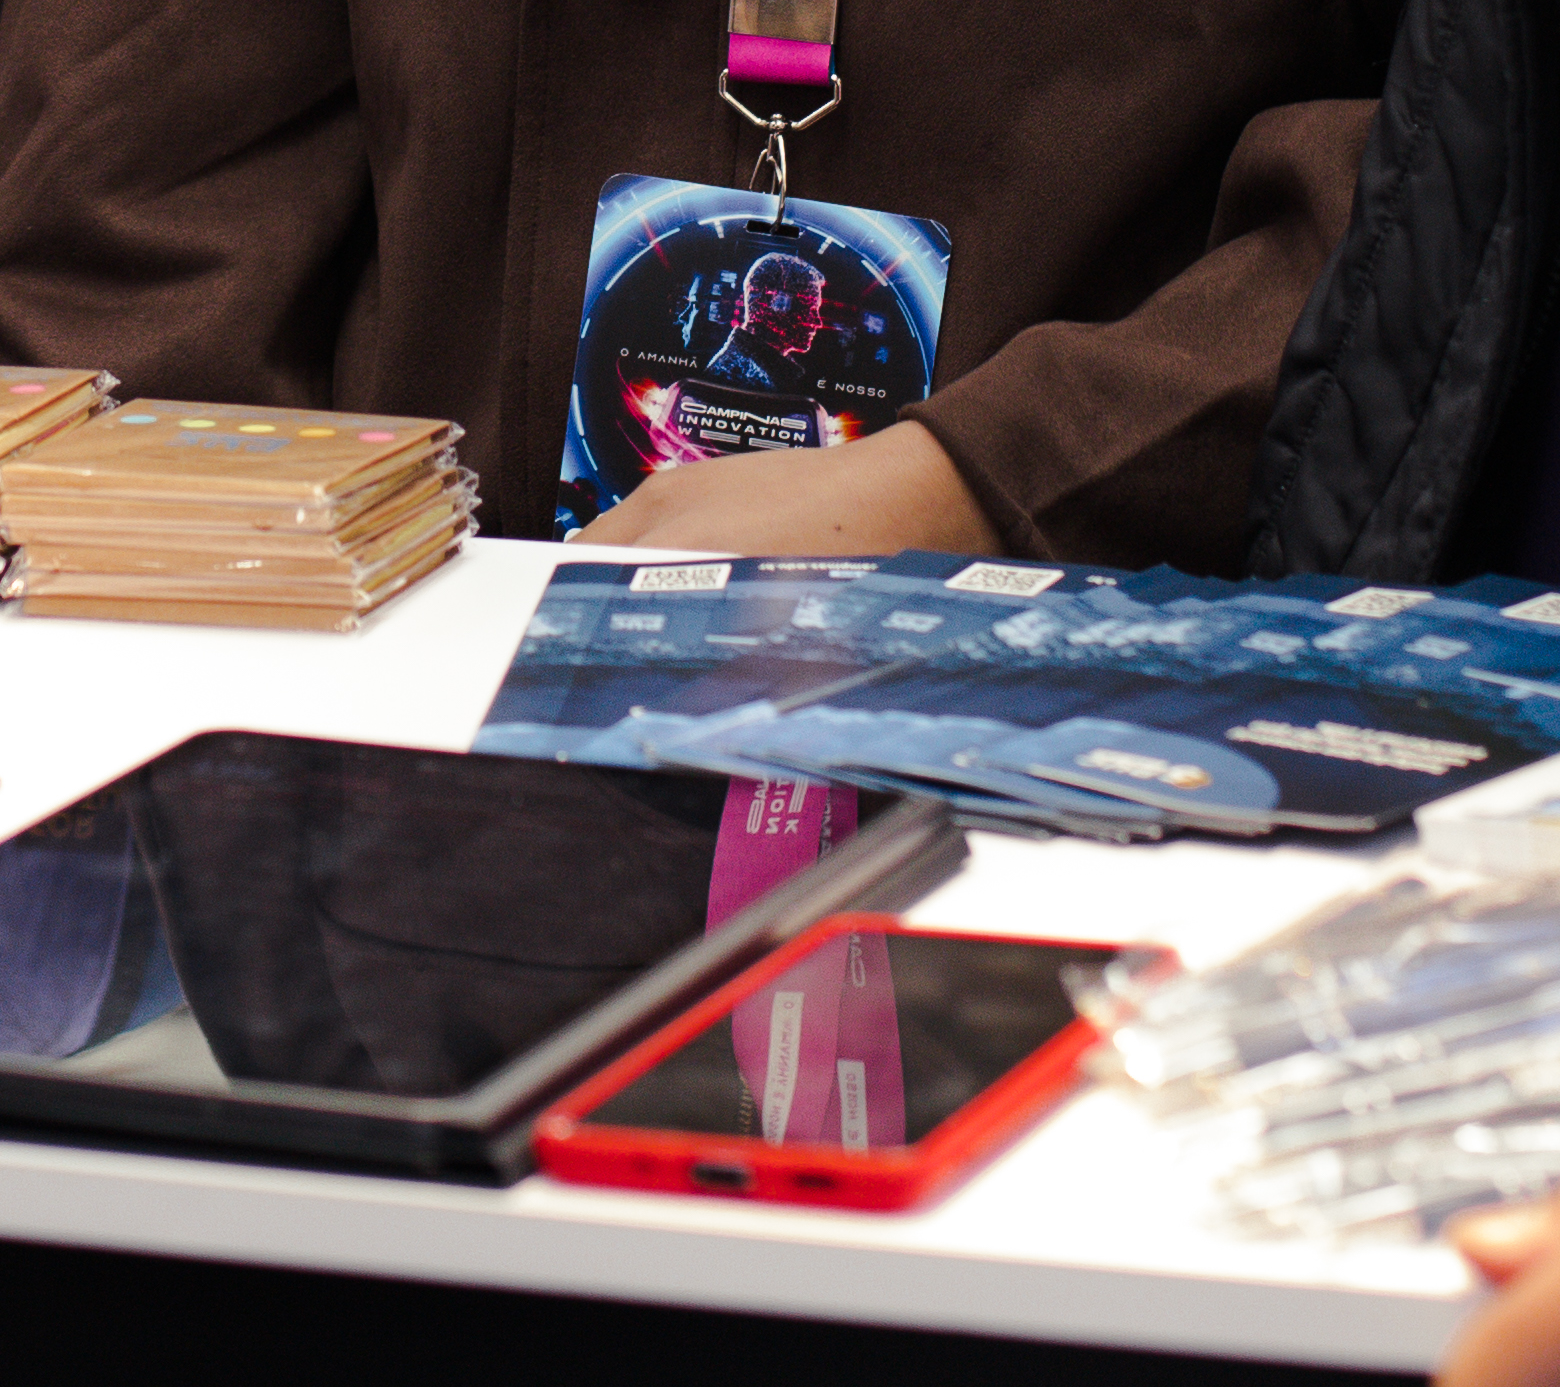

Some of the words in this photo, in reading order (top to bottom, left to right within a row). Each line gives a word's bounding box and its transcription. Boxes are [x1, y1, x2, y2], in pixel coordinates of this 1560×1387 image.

[620, 347, 629, 357] O
[637, 350, 698, 369] AMANHÃ
[816, 377, 826, 389] É
[834, 382, 887, 399] NOSSO
[680, 401, 807, 430] CAMPINAS
[677, 425, 803, 450] WEE
[679, 414, 806, 443] INNOVATION
